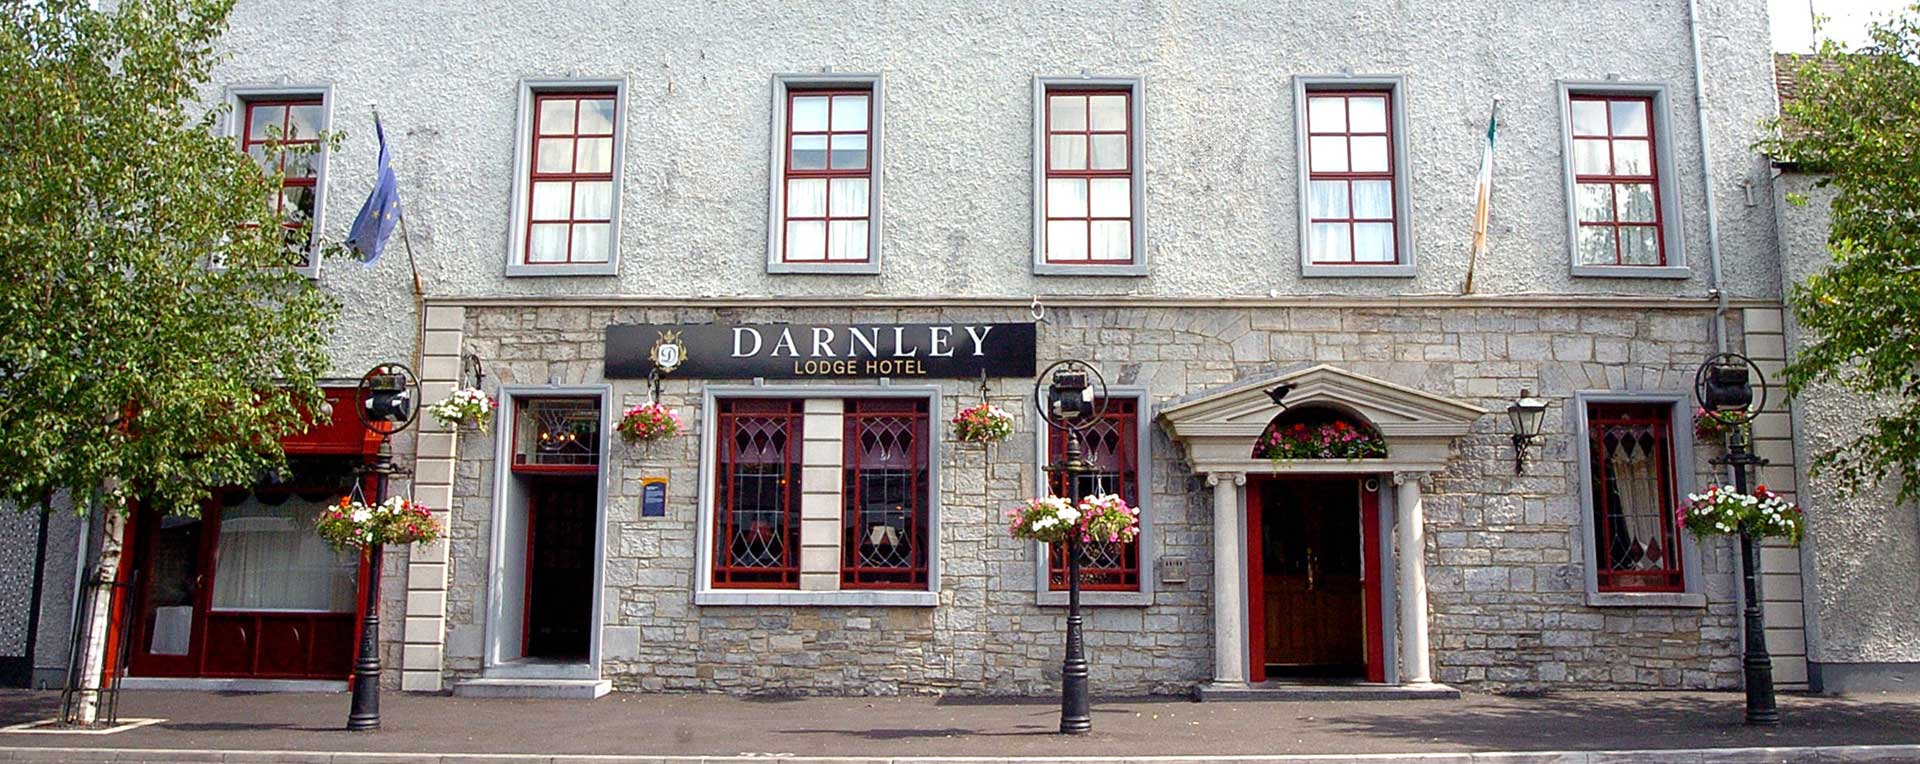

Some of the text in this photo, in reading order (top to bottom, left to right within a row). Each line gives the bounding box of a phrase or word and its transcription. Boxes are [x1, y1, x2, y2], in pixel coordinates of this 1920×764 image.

[731, 325, 993, 357] DARNLEY
[794, 360, 927, 375] LODGE HOTEL
